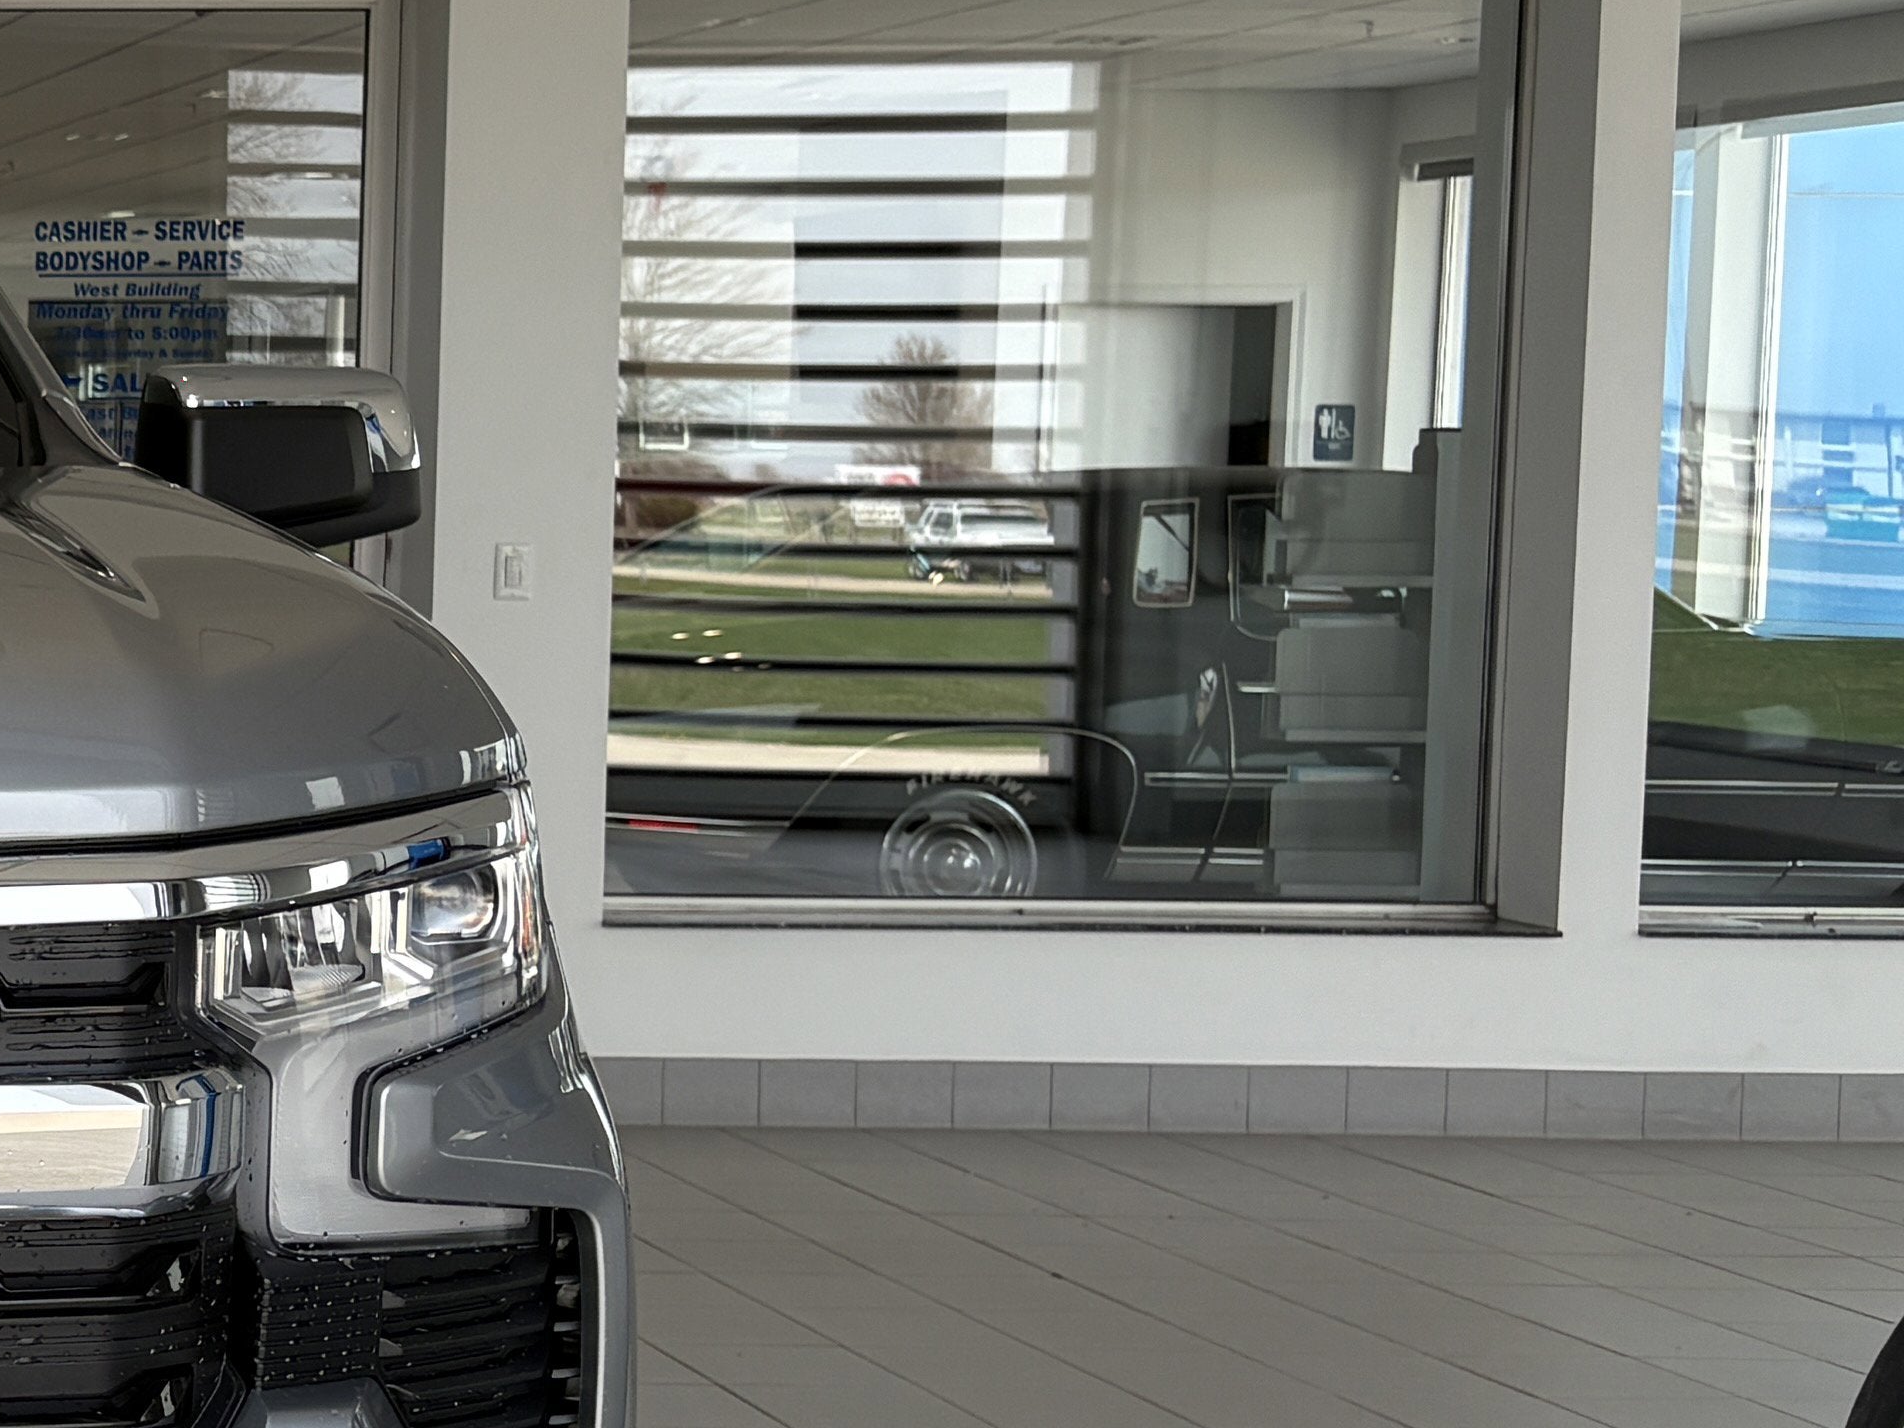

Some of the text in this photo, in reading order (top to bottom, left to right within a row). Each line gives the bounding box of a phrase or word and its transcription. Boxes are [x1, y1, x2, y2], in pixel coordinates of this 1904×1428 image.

[35, 220, 245, 242] CASHIER SERVICE
[35, 251, 242, 271] BODYSHOP PARTS
[74, 283, 201, 300] West Building
[36, 303, 228, 321] Monday thru Friday
[127, 328, 145, 340] to
[93, 373, 143, 393] SAL
